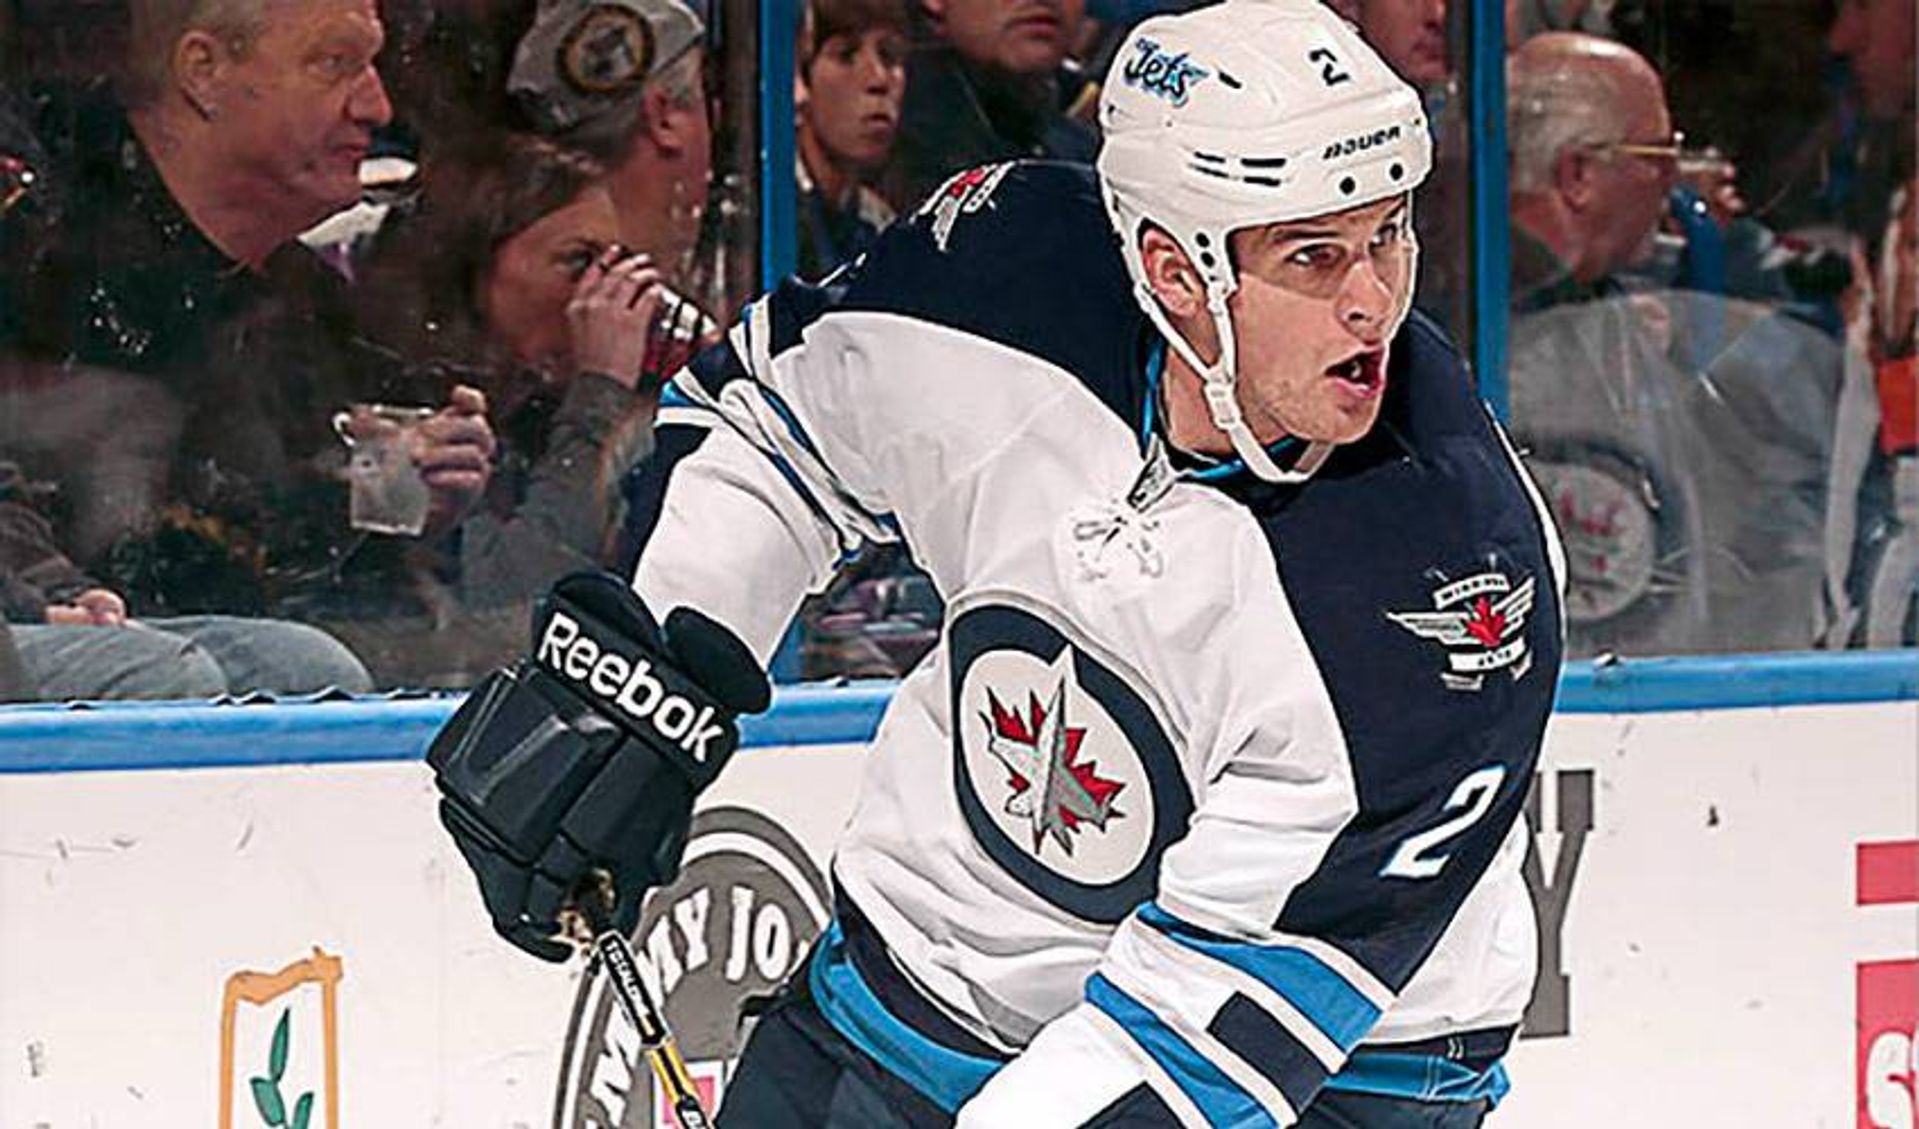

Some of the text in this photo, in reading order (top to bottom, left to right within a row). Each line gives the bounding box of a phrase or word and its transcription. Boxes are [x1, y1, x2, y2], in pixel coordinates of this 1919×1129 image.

[1123, 38, 1210, 109] Jets
[1309, 47, 1349, 86] 2
[537, 611, 724, 763] Reebok
[1378, 763, 1506, 878] 2
